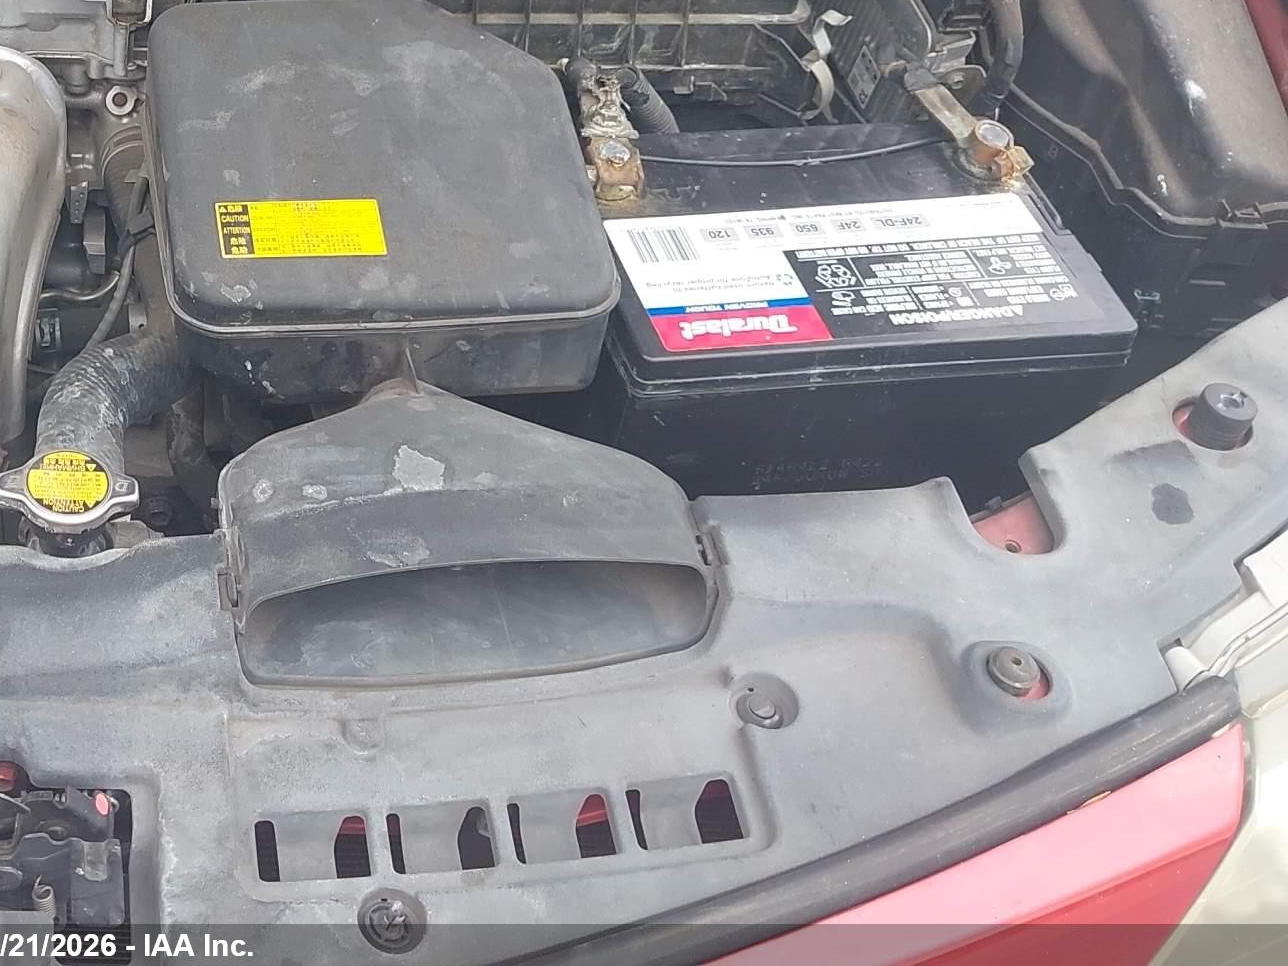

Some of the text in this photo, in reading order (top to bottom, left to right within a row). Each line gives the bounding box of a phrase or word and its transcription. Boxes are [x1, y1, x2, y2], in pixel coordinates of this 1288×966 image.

[221, 214, 249, 223] CAUTION
[876, 217, 922, 227] 24F-DL
[223, 226, 251, 234] ATTENTION
[795, 223, 818, 233] 650
[838, 220, 861, 231] 24F
[708, 230, 731, 239] 120
[751, 227, 774, 237] 935
[679, 313, 798, 340] Duralast
[42, 498, 84, 507] ATTENTION
[52, 504, 85, 513] CAUTION
